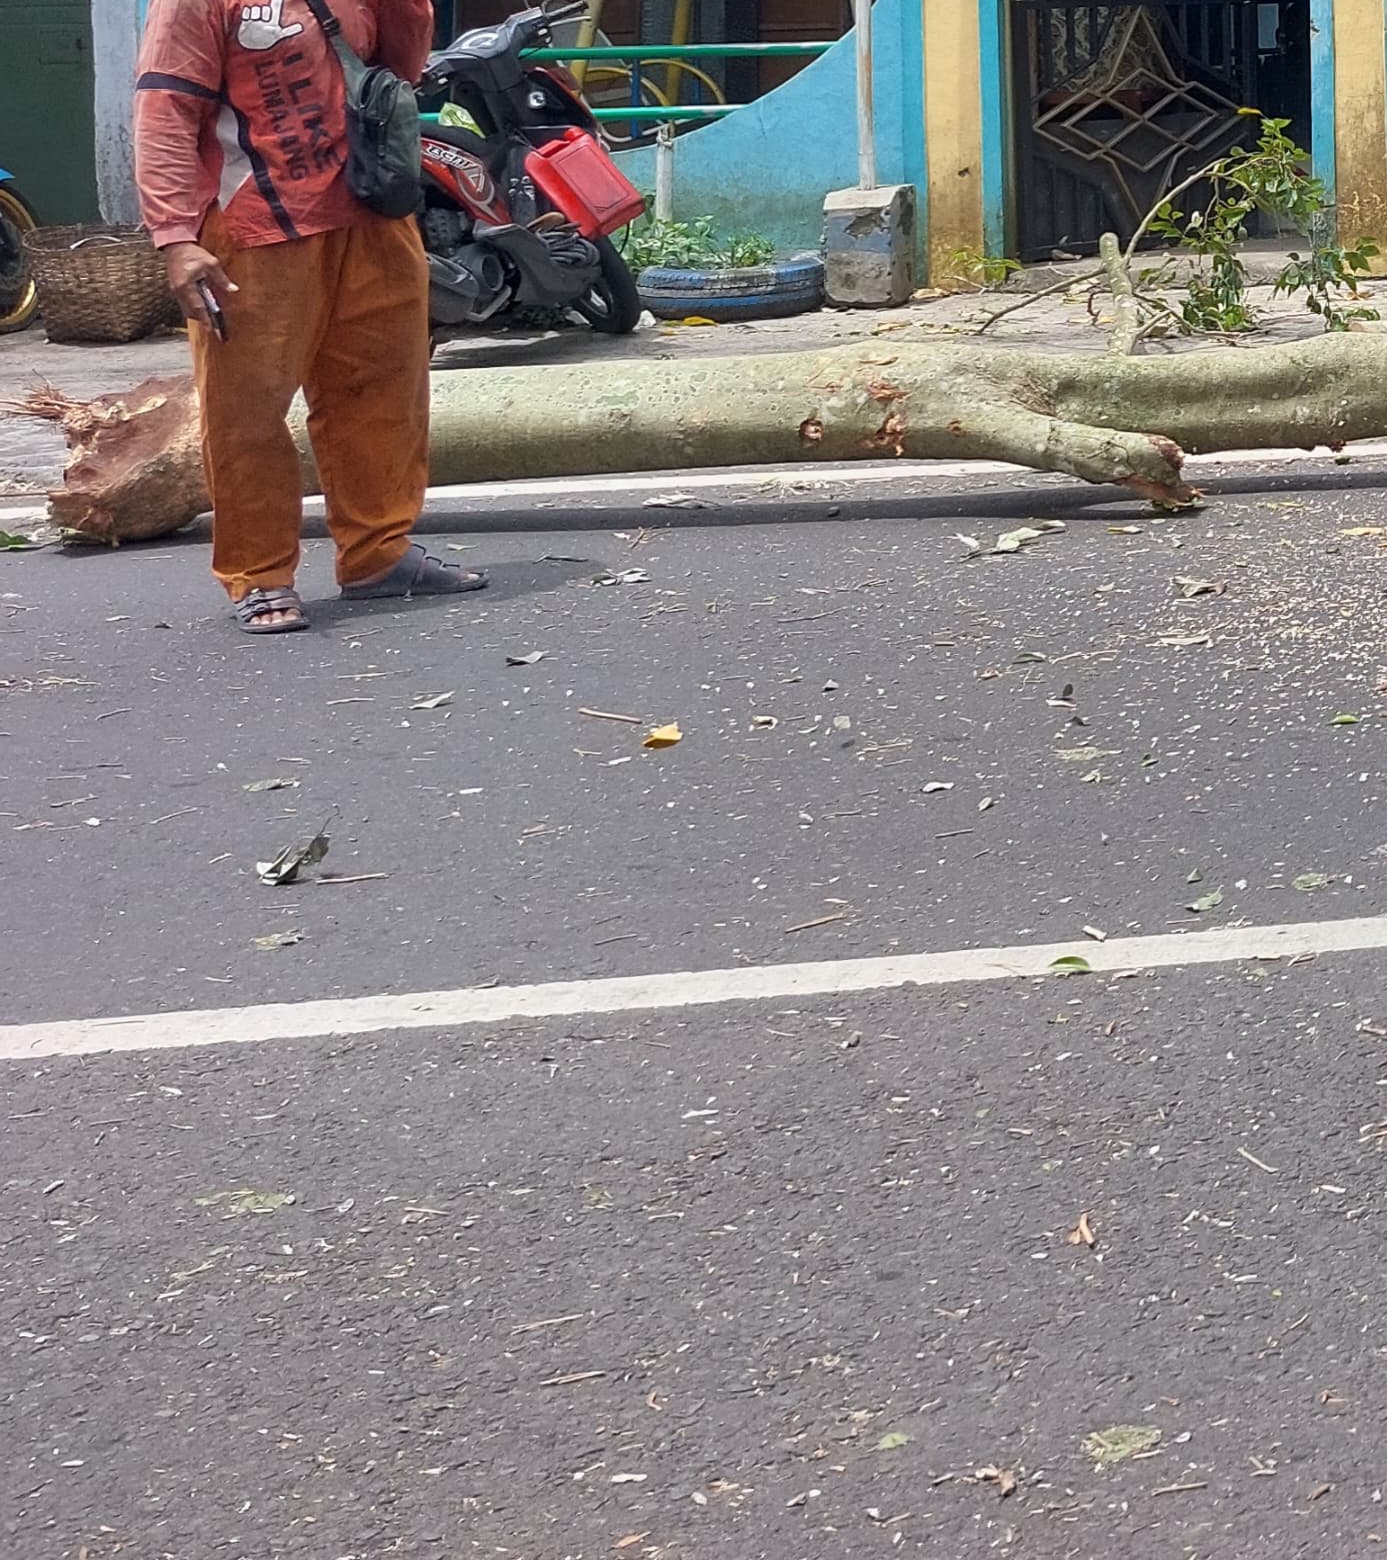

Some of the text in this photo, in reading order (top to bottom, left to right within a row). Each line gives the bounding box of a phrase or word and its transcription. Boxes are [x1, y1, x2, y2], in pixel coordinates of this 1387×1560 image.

[254, 60, 308, 180] LUMAJANG
[282, 52, 345, 173] I LIKE
